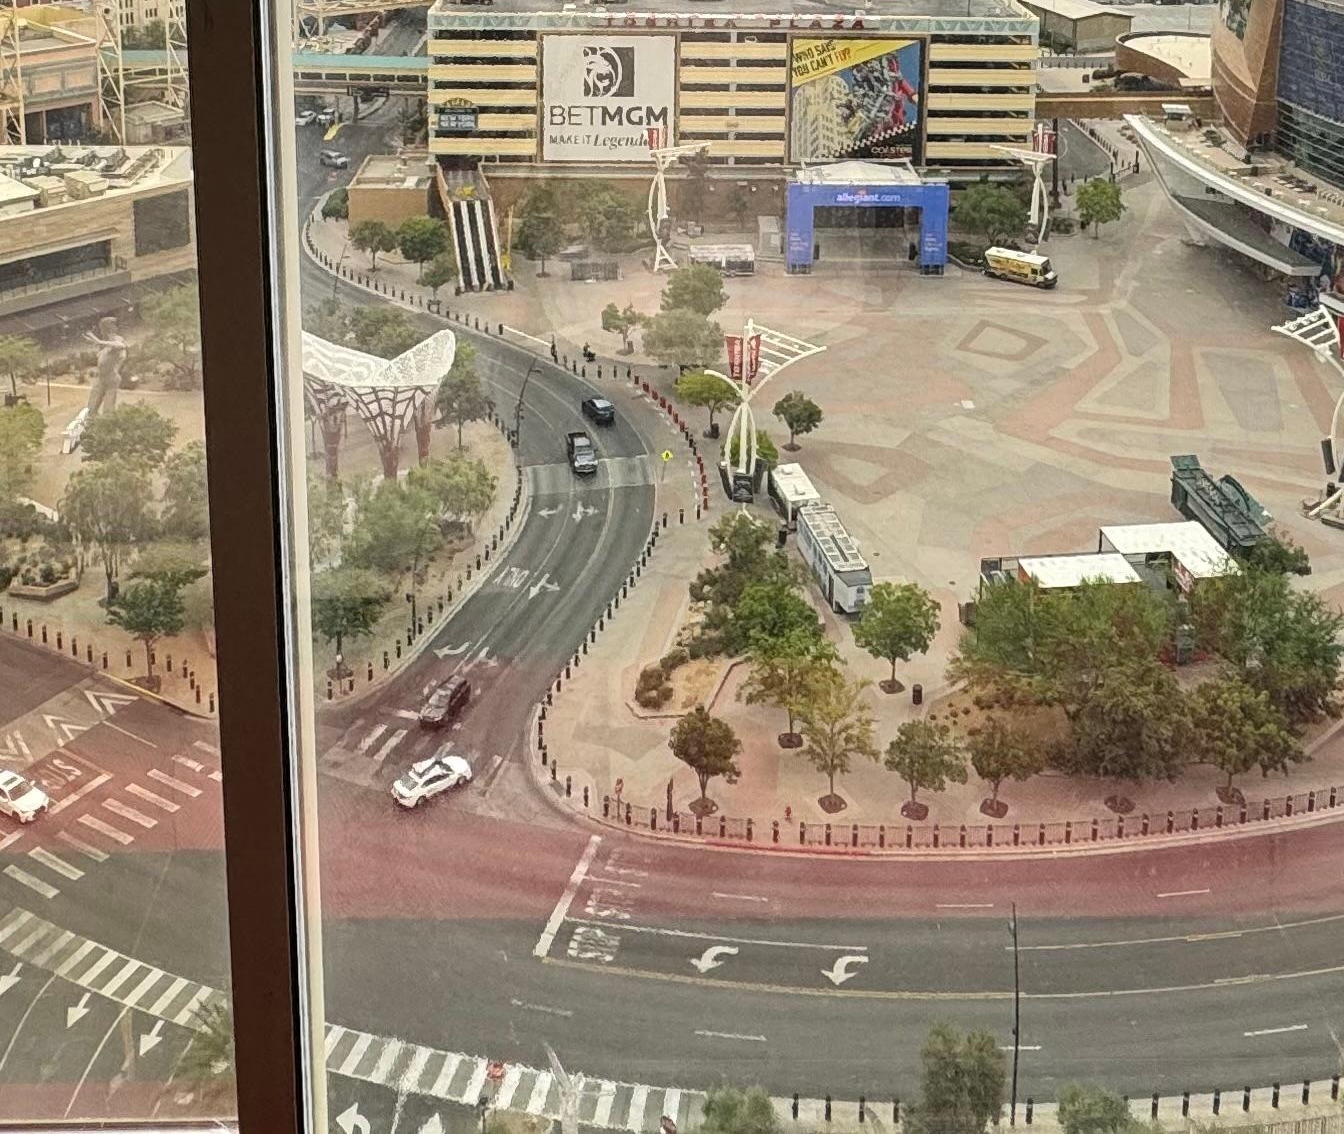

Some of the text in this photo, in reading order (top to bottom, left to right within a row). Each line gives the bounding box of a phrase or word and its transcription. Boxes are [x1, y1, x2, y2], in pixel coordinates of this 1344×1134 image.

[769, 14, 865, 29] PLAZA
[792, 39, 837, 64] WHO SAYS
[792, 62, 810, 78] YOU
[549, 105, 668, 126] BETMGM
[549, 134, 579, 145] MAKE
[582, 134, 592, 145] IT
